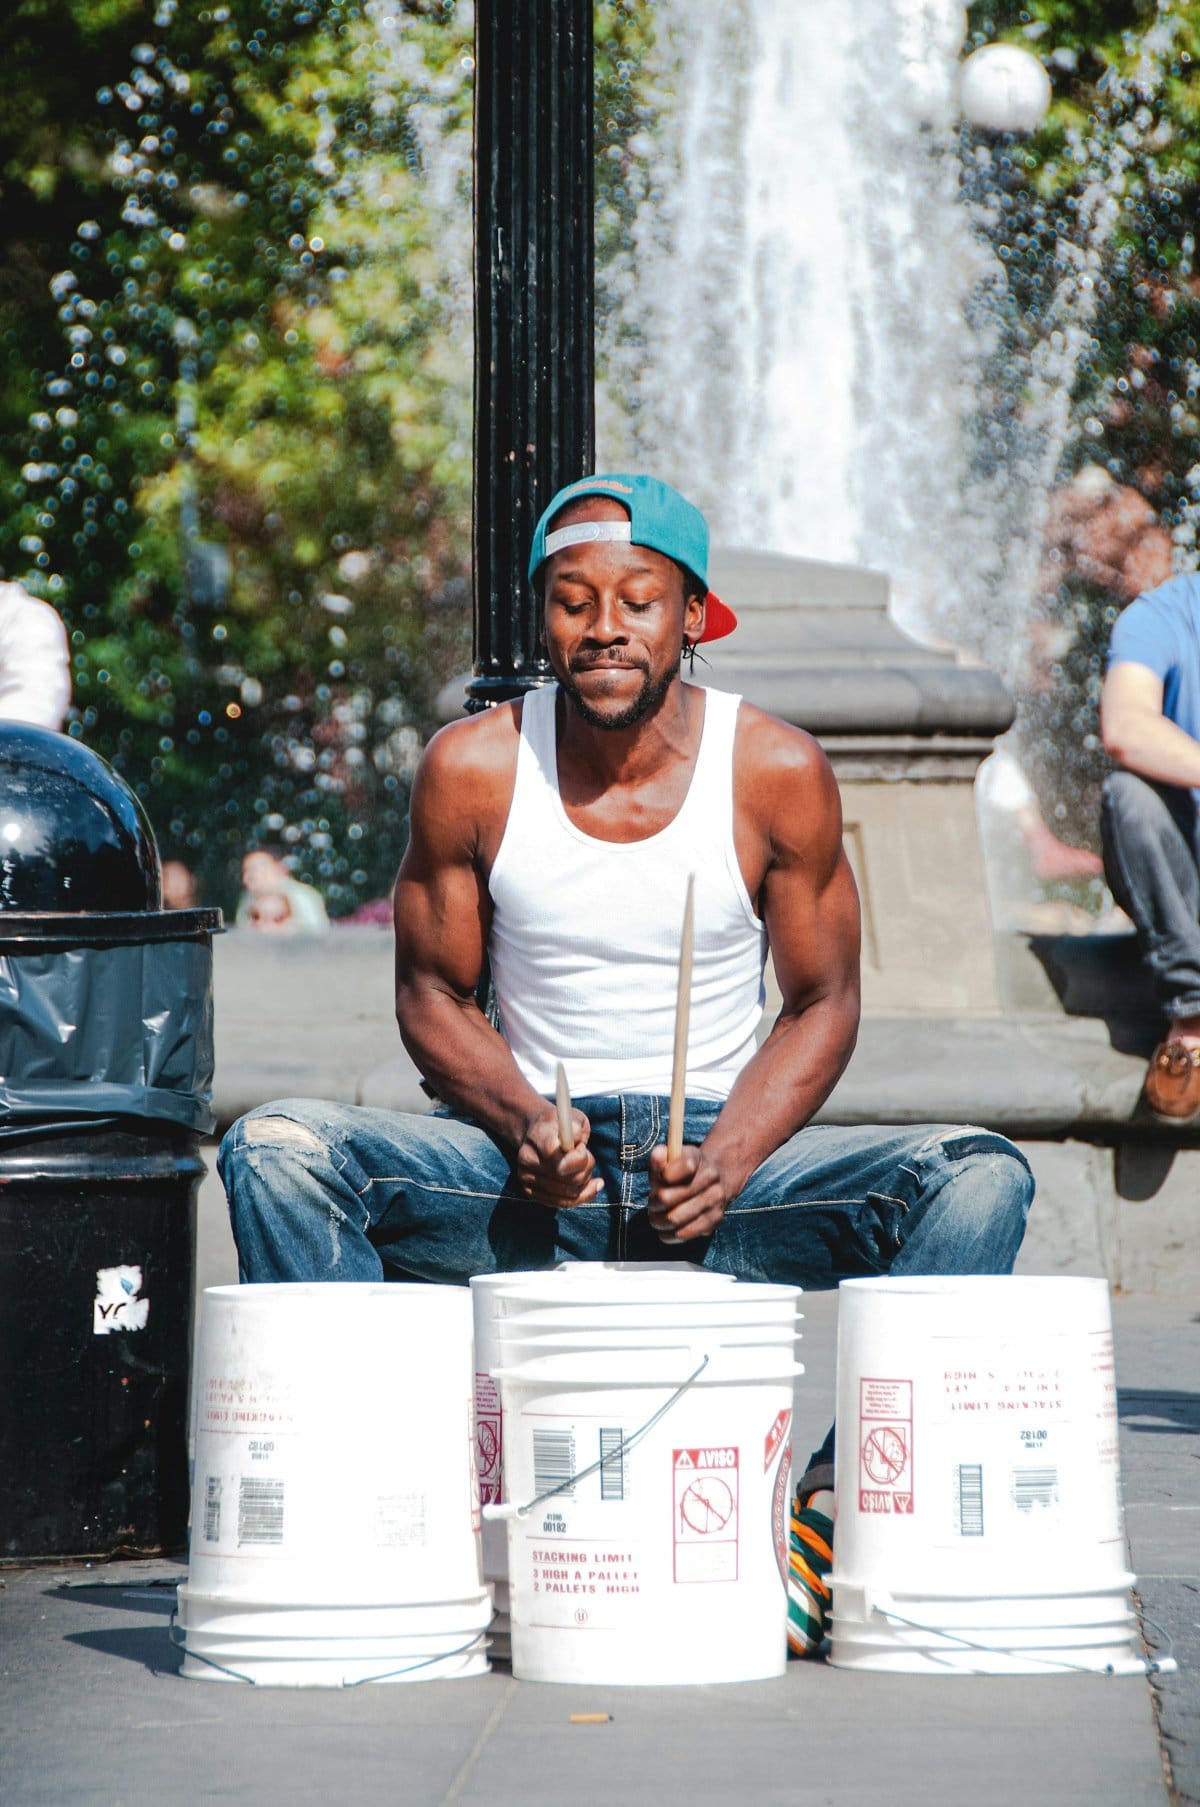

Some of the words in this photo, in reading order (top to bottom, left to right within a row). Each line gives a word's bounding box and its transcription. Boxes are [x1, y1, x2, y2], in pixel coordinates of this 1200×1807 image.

[950, 1401, 989, 1411] LIMIT
[996, 1400, 1063, 1410] STACKING
[1019, 1429, 1049, 1440] 00182
[697, 1449, 736, 1468] AVISO
[861, 1490, 892, 1513] AVISO
[542, 1521, 567, 1533] 00182
[531, 1550, 588, 1562] STACKING
[594, 1553, 633, 1563] LIMIT
[532, 1569, 539, 1579] 3
[542, 1569, 569, 1580] HIGH
[574, 1570, 582, 1580] A
[588, 1571, 639, 1580] PALLET
[533, 1582, 540, 1592] 2
[545, 1583, 597, 1594] PALLETS
[606, 1585, 640, 1594] HIGH
